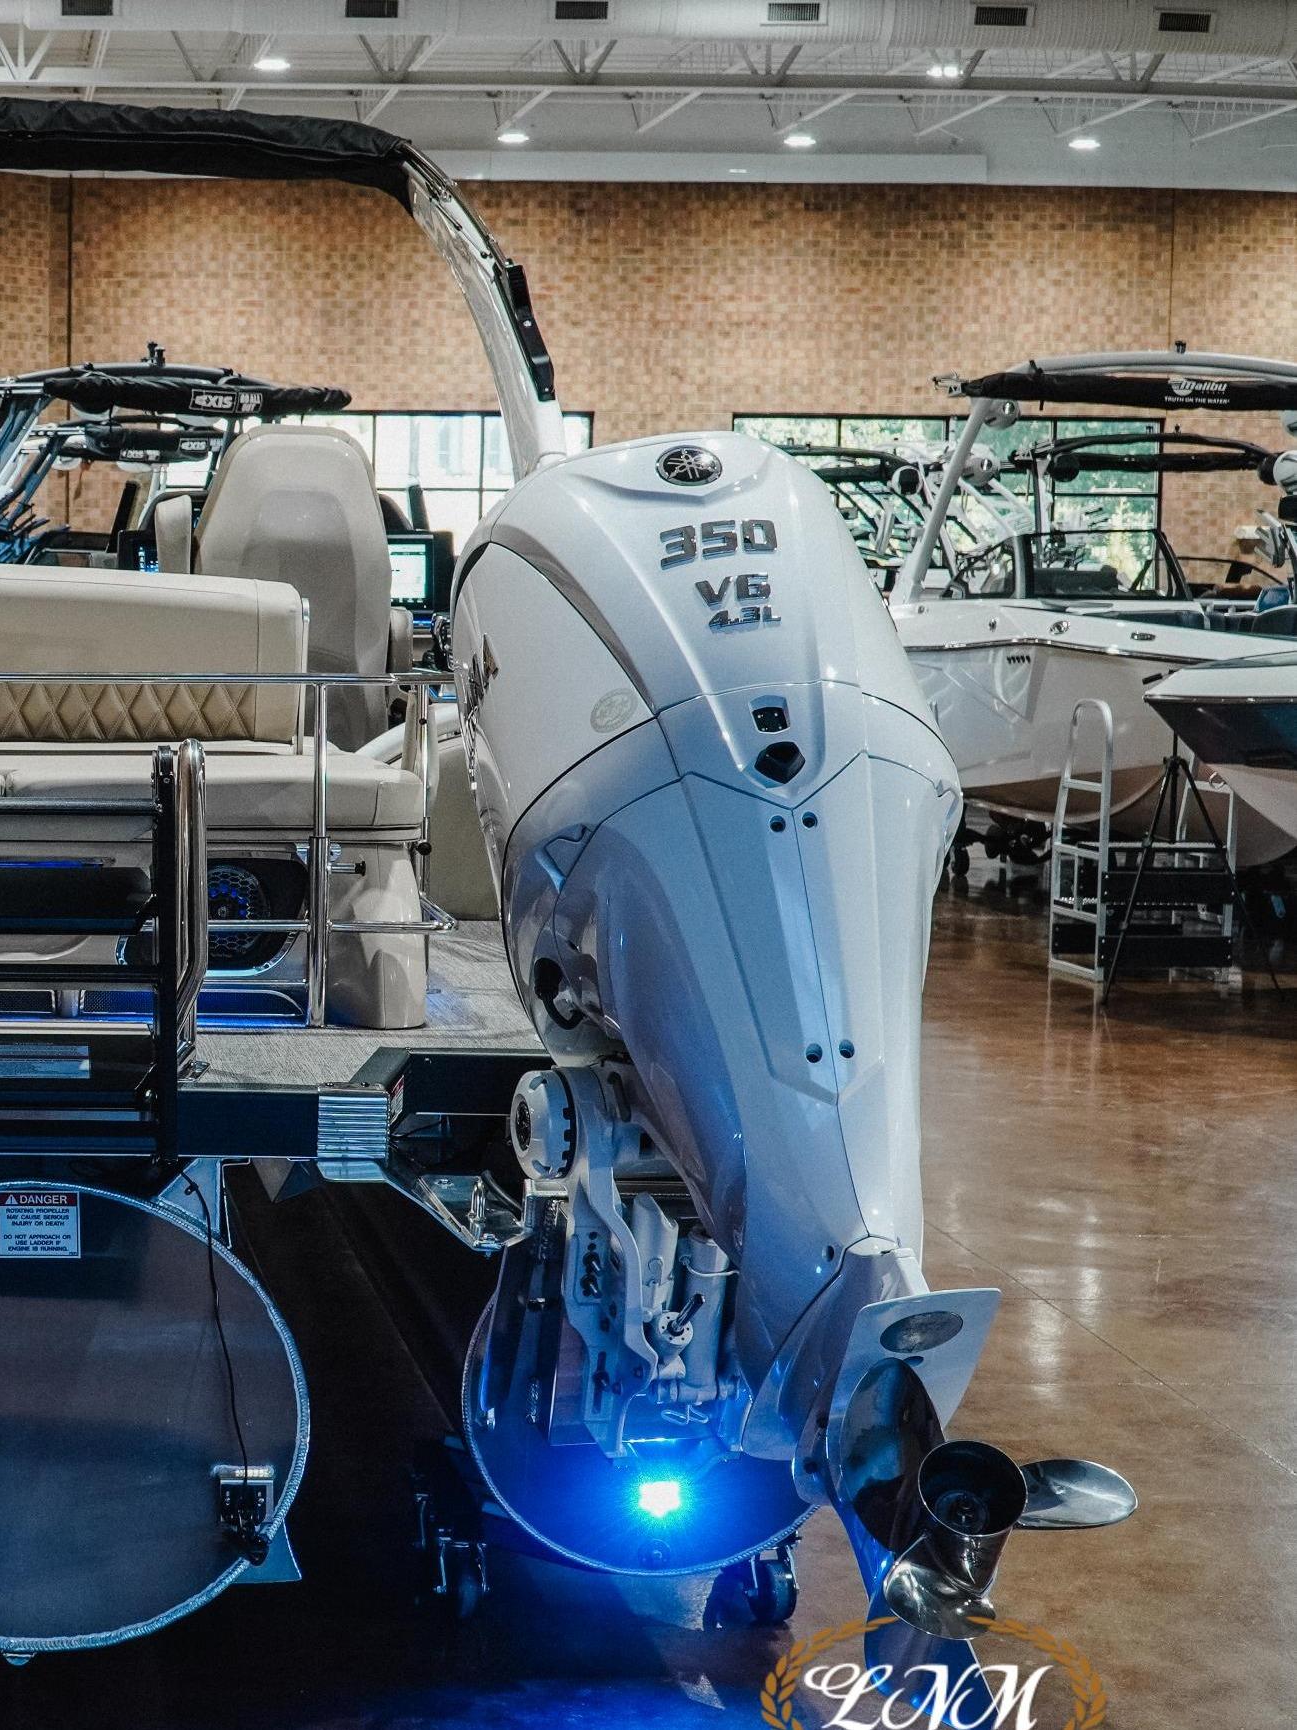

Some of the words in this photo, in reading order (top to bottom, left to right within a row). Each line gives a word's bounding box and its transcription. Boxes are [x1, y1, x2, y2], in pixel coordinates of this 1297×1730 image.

[659, 519, 778, 570] 350
[695, 573, 772, 609] V6
[19, 1194, 68, 1204] DANGER
